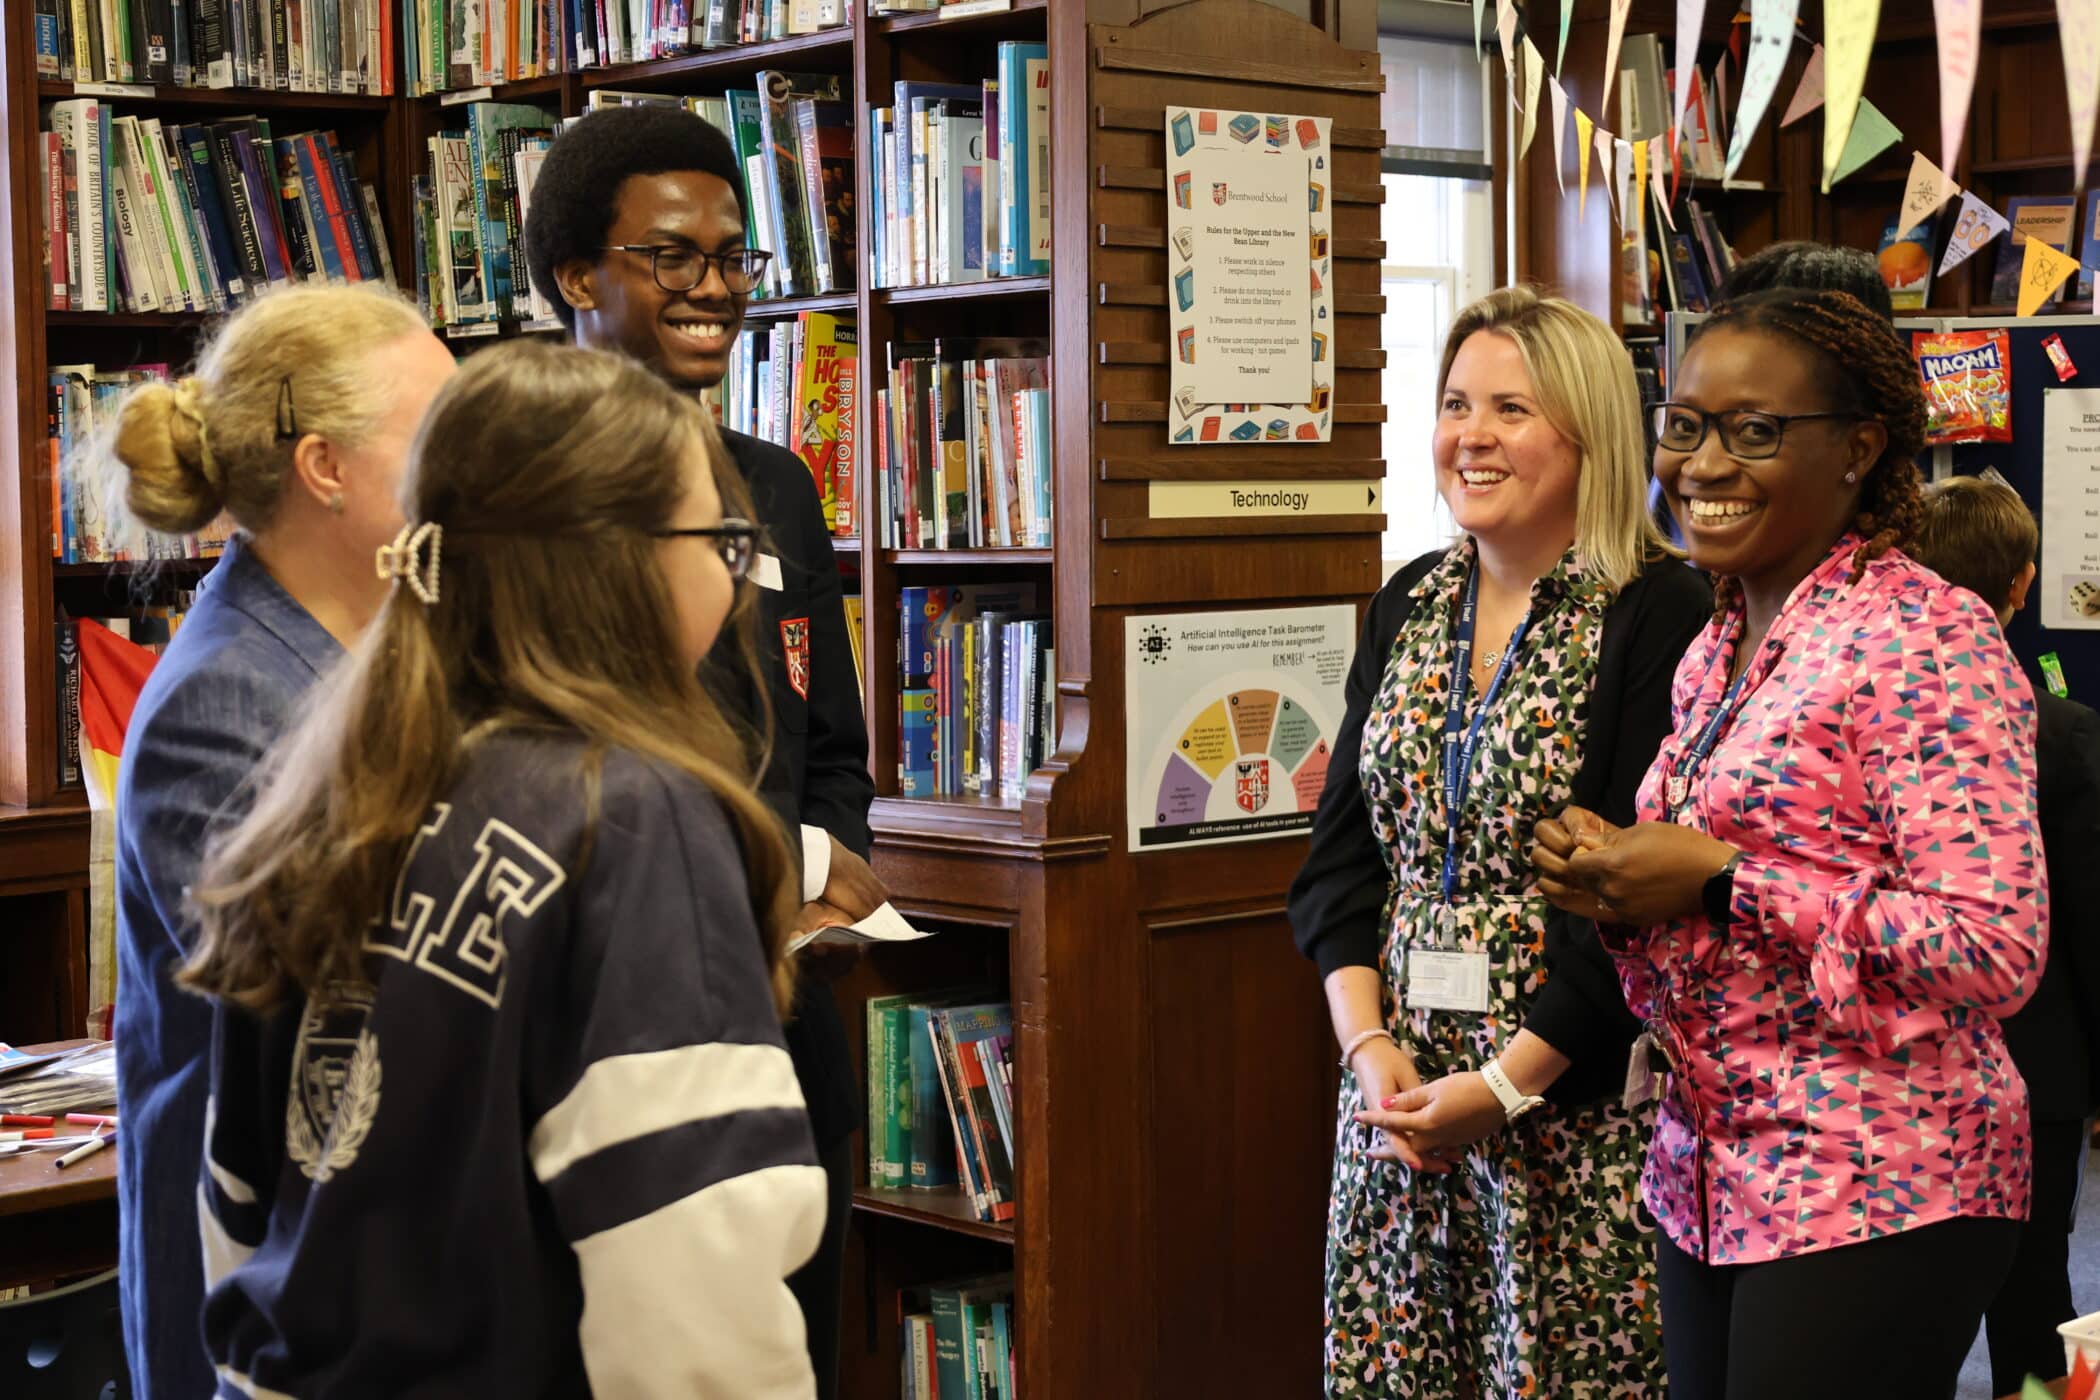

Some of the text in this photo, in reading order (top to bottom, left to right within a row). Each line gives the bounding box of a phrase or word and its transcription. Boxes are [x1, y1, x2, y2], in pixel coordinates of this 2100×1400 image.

[472, 146, 480, 160] OF
[803, 134, 818, 192] Medicine
[87, 122, 106, 288] BOOK OF BRITAIN'S COUNTRYSIDE
[476, 184, 485, 218] LIVING
[1228, 191, 1288, 204] Brentwood School
[116, 188, 134, 237] Biology
[2016, 216, 2066, 226] LEADERSHIP
[230, 182, 258, 272] Life Sciences
[1206, 226, 1296, 238] Rules for the Upper and the New
[480, 221, 488, 254] WORLD
[1248, 238, 1270, 248] Library
[1224, 256, 1242, 264] Please
[1243, 257, 1257, 265] work
[1266, 258, 1285, 266] silence
[1228, 268, 1276, 277] respecting others
[1219, 286, 1237, 294] Please
[1256, 288, 1272, 296] bring
[1224, 296, 1240, 304] drink
[1240, 296, 1252, 304] into
[1262, 298, 1280, 307] library
[1216, 316, 1233, 324] Please
[1254, 316, 1262, 325] off
[1263, 318, 1276, 326] your
[1276, 317, 1296, 326] phones
[1213, 336, 1232, 344] Please
[1243, 338, 1272, 346] computers
[1274, 336, 1284, 344] and
[816, 345, 836, 358] THE
[1221, 346, 1230, 354] for
[1230, 346, 1254, 355] working
[1238, 366, 1256, 374] Thank
[1925, 348, 1996, 378] MAOAM
[837, 379, 852, 477] BRYSON
[1230, 490, 1309, 510] Technology
[1180, 623, 1326, 640] Artificial Intelligence Task Barometer
[1187, 635, 1326, 652] How can you use AI for this assignment?
[1451, 694, 1460, 712] Staff
[70, 669, 80, 762] RICHARD DAWKINS
[1464, 735, 1473, 754] Staff
[1446, 790, 1454, 809] Staff
[1213, 824, 1241, 833] reference
[888, 1064, 896, 1117] Psychotherapy
